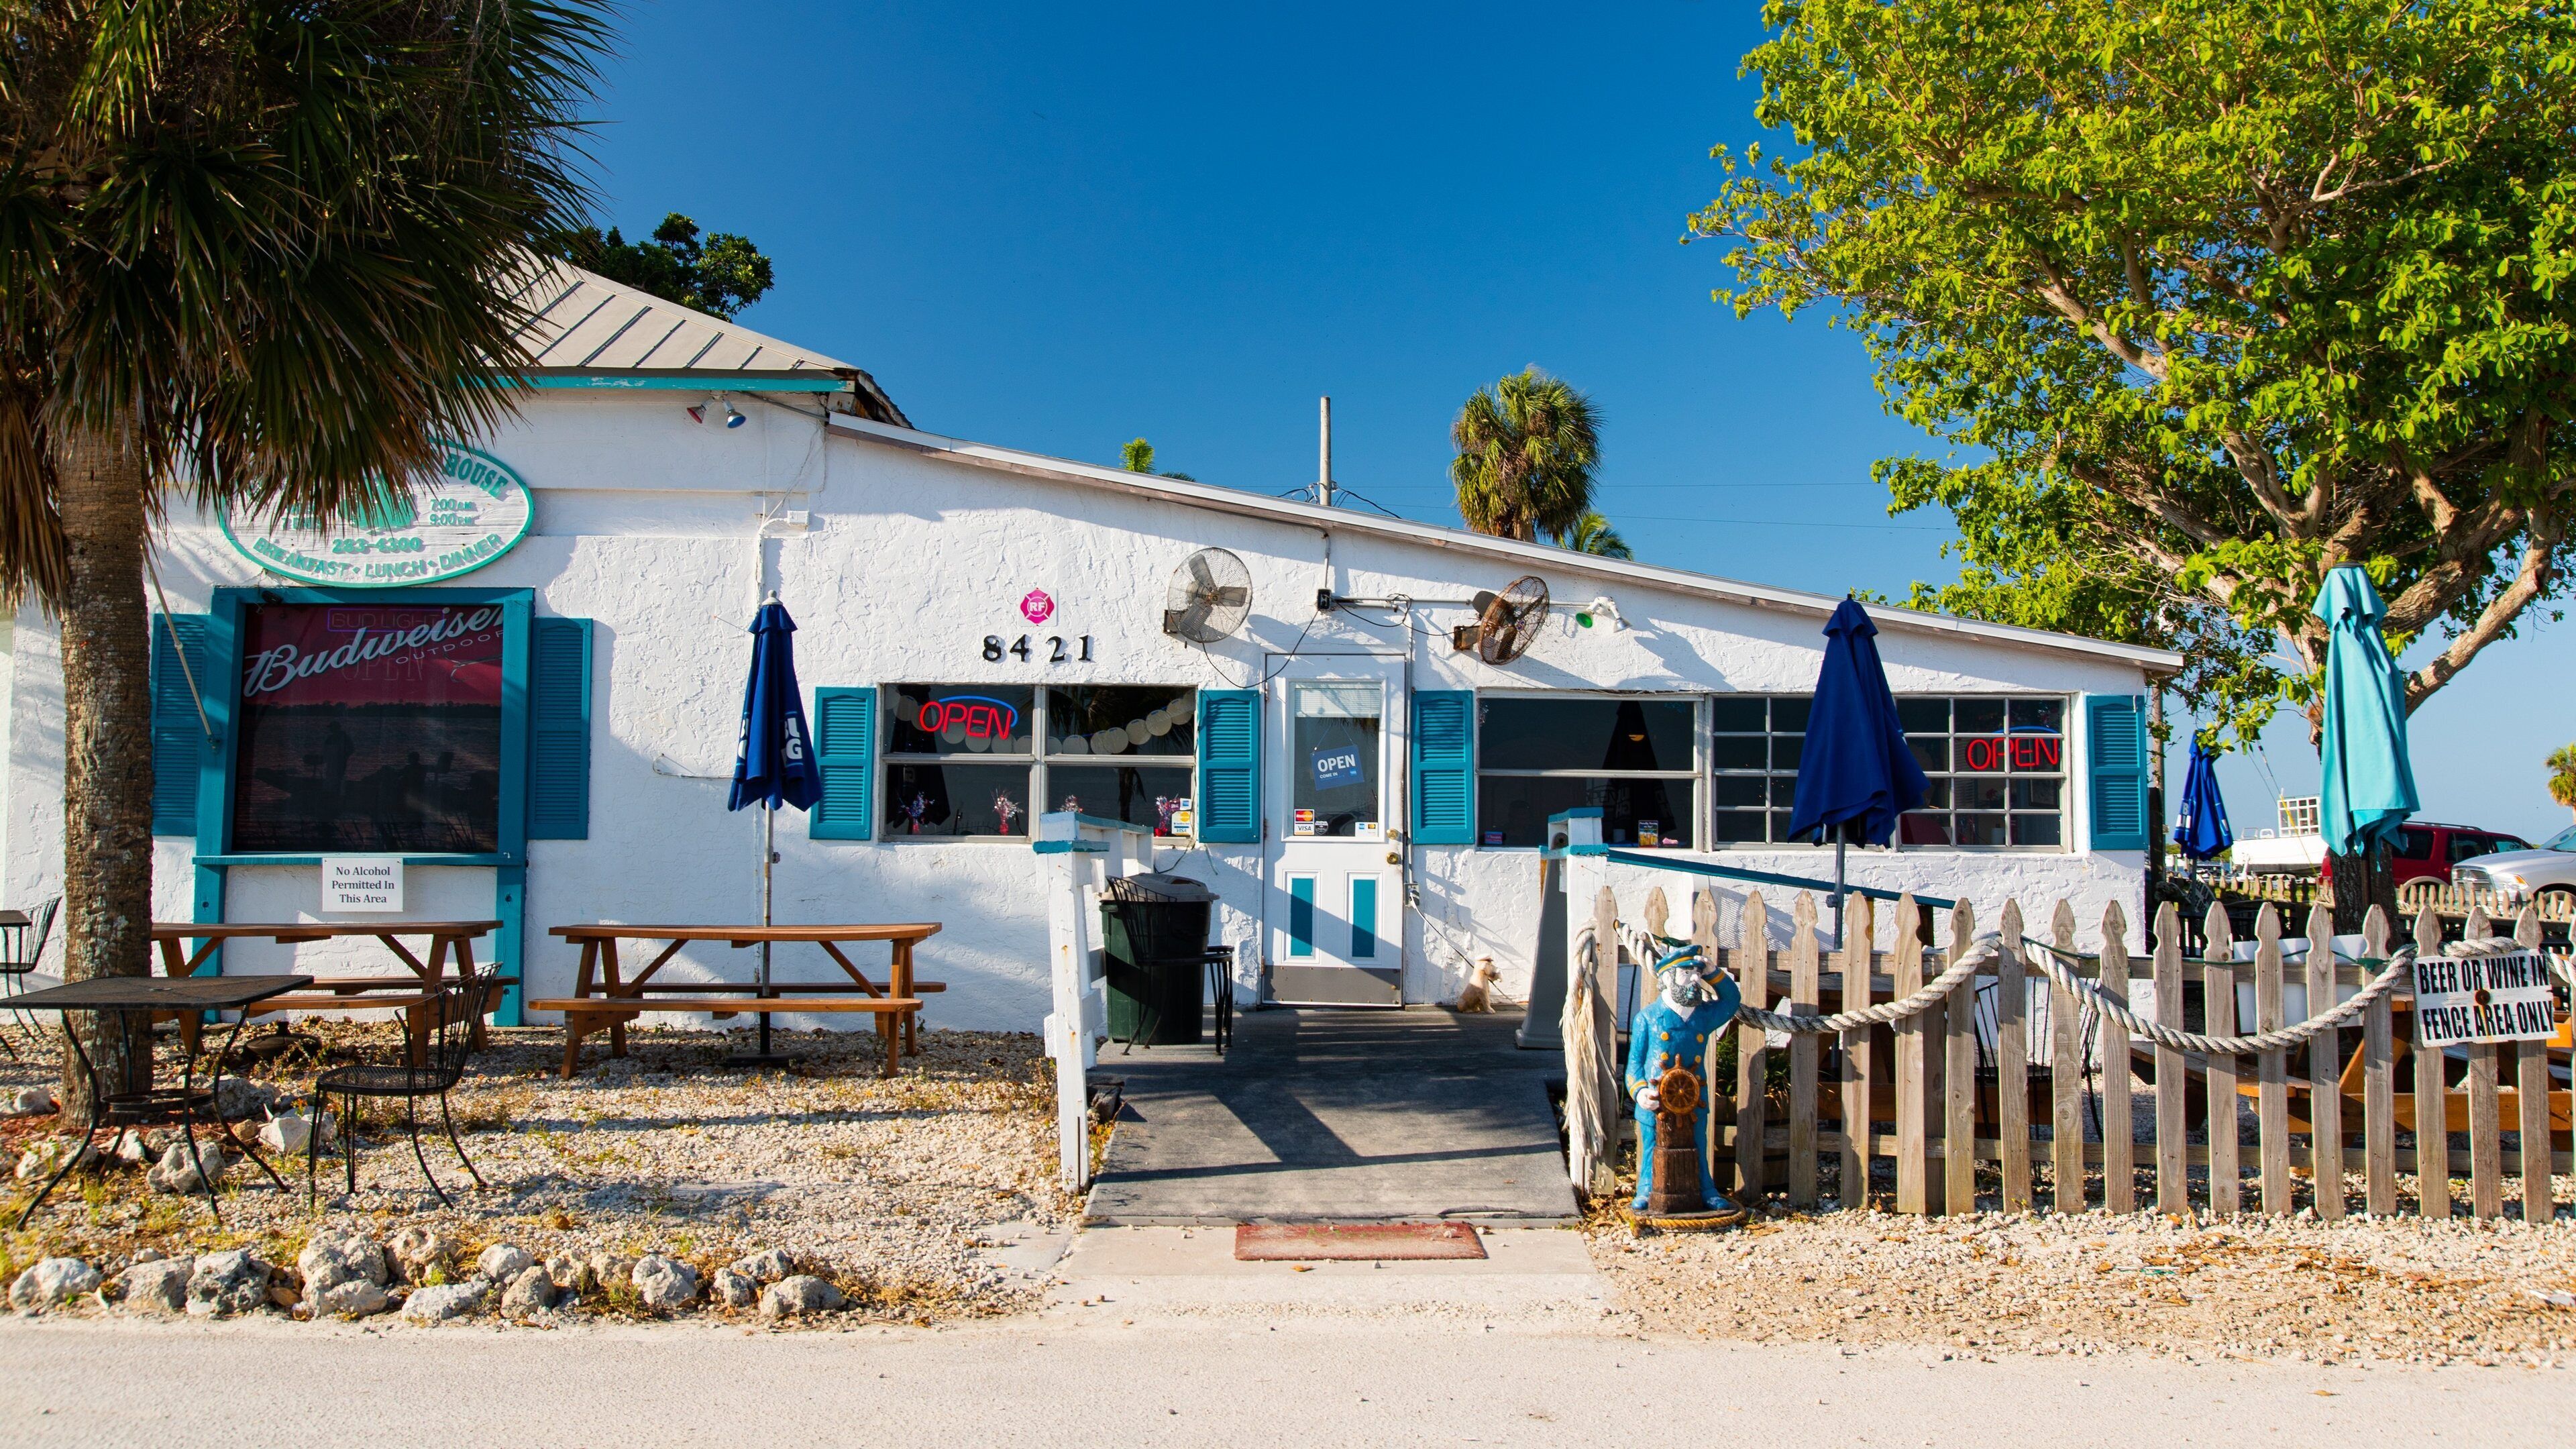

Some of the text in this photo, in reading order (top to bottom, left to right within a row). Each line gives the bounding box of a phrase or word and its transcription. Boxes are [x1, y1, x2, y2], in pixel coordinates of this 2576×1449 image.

[443, 453, 508, 500] HOUSE
[430, 498, 455, 511] 7:00
[429, 513, 455, 525] 9:00
[332, 537, 423, 553] 283-4300
[253, 533, 504, 577] BREAKFAST LUNCH DINNER
[1029, 602, 1045, 612] RF
[331, 612, 377, 629] BUD
[982, 634, 1091, 663] 8421
[919, 701, 1012, 740] OPEN
[1966, 737, 2059, 771] OPEN
[1318, 754, 1356, 772] OPEN
[336, 867, 390, 875] No Alcohol
[332, 880, 394, 889] Permitted In
[339, 894, 387, 903] This Area
[2418, 955, 2549, 994] BEER OR WINE IN
[2422, 1000, 2554, 1040] FENCE AREA ONLY
